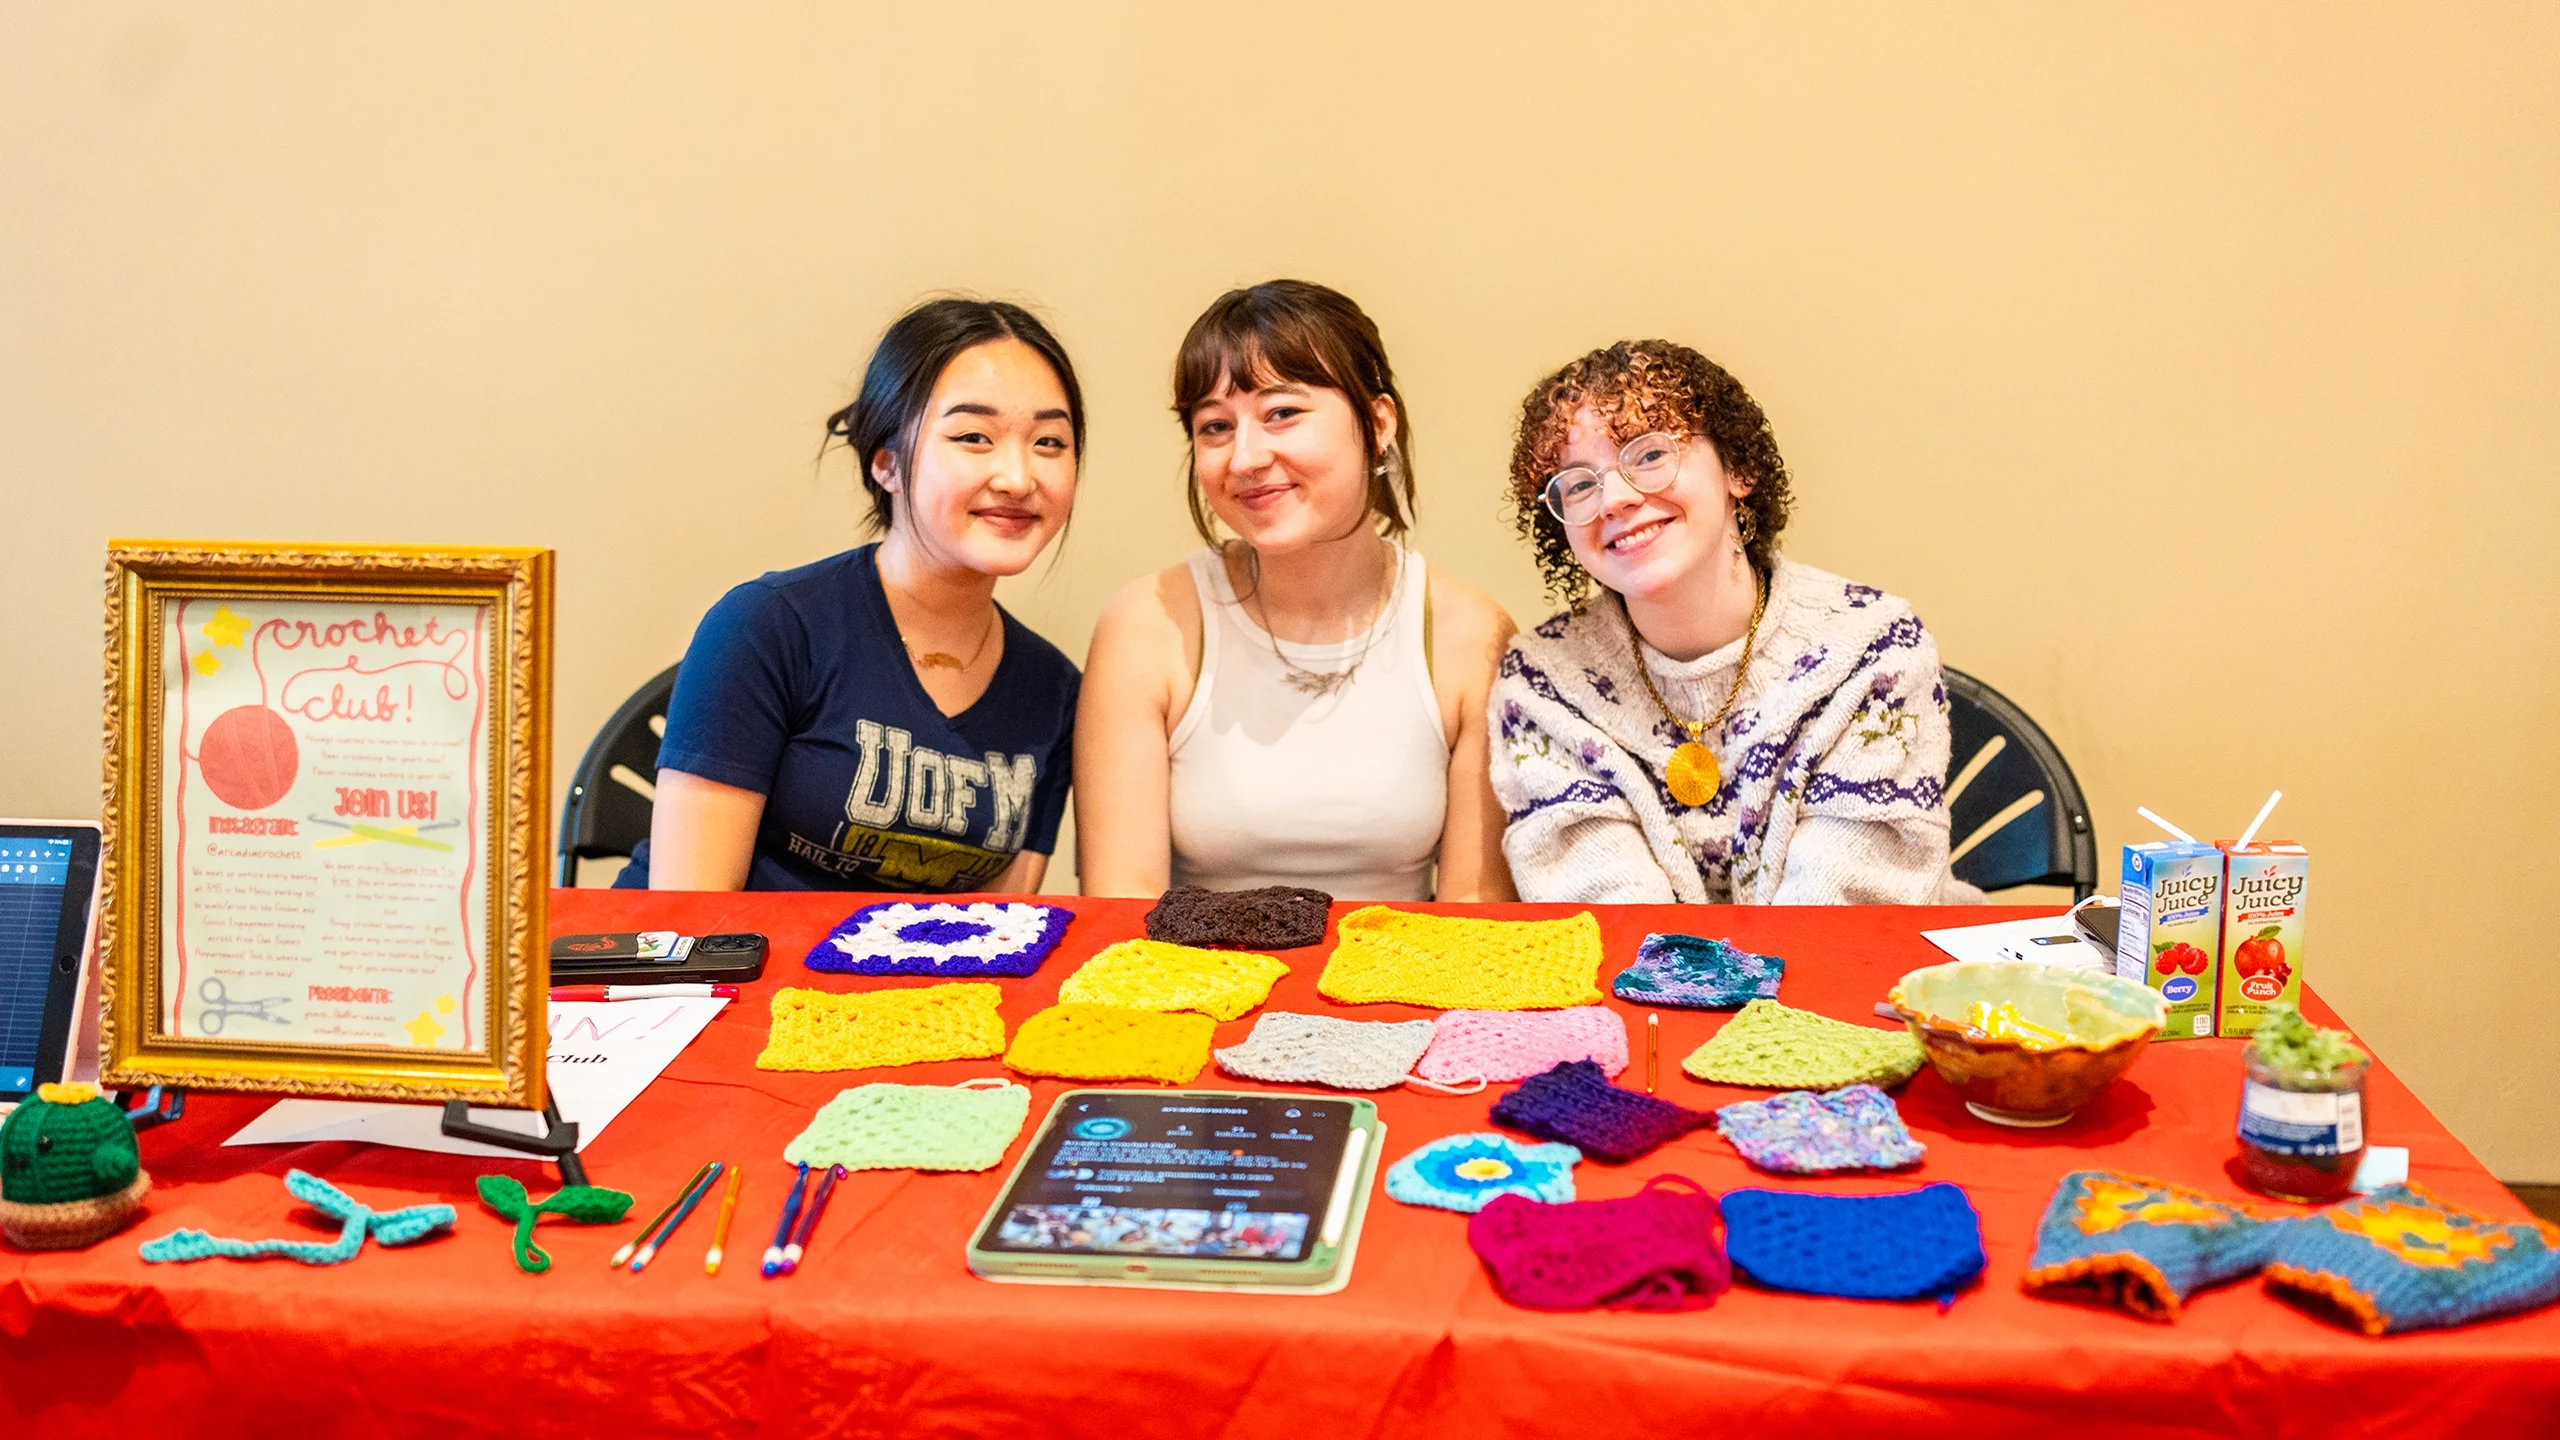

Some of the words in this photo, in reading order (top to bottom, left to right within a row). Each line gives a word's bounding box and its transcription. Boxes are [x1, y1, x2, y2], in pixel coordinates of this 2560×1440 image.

[271, 611, 441, 650] crochet
[303, 684, 414, 723] club!
[788, 837, 828, 867] HAIL
[2155, 875, 2218, 898] Juicy
[2232, 876, 2304, 896] Juicy
[2158, 894, 2209, 913] Juice
[2236, 893, 2294, 911] Juice
[2166, 984, 2193, 995] Berry
[2247, 987, 2277, 996] Punch
[2250, 981, 2274, 990] Fruit
[2195, 1016, 2209, 1026] 100
[547, 1054, 608, 1064] Club
